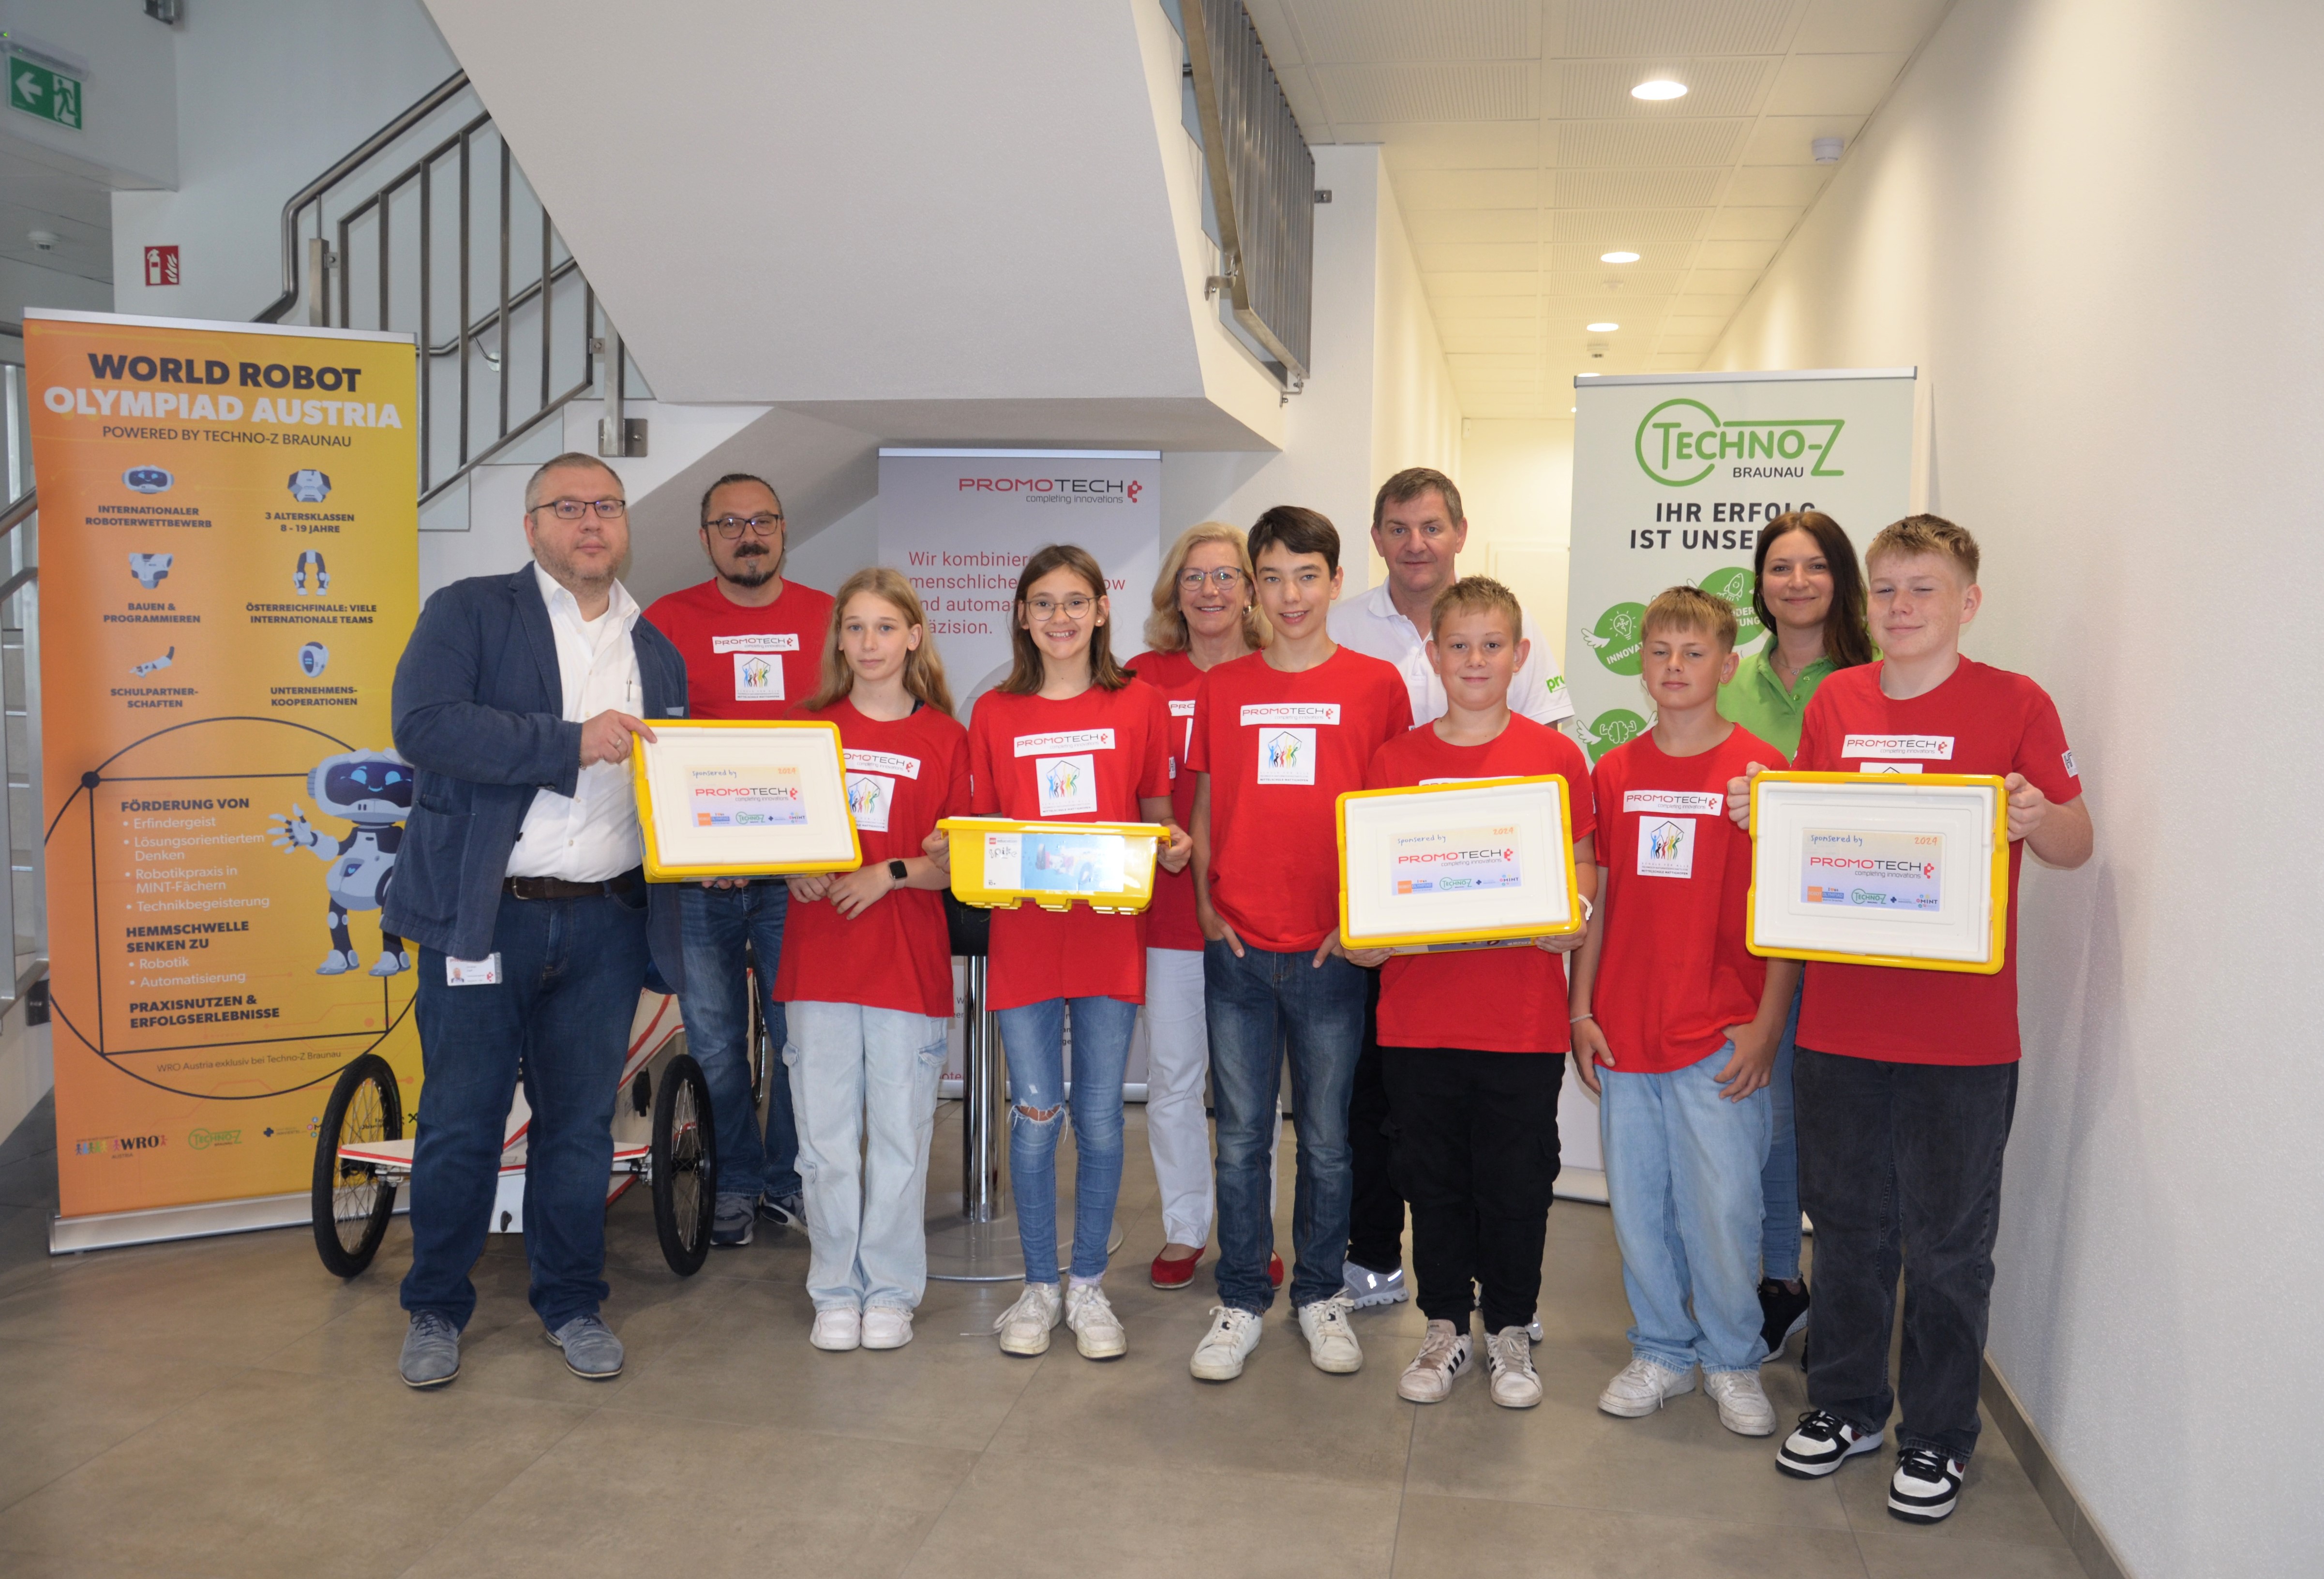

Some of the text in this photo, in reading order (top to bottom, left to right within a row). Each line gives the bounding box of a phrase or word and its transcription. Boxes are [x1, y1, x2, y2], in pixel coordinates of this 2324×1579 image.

[87, 353, 361, 391] WORLD ROBOT
[44, 387, 402, 428] OLYMPIAD AUSTRIA
[103, 427, 351, 447] POWERED BY TECHNO-Z BRAUNAU
[1733, 467, 1803, 478] BRAUNAU
[959, 478, 1123, 492] PROMOTECH
[1026, 494, 1123, 504] completing innovations
[98, 505, 199, 515] INTERNATIONALER
[274, 513, 354, 521] ALTERSKLASSEN
[1656, 503, 1702, 522] IHR
[86, 517, 212, 528] ROBOTERWETTBEWERB
[309, 525, 340, 534] JAHRE
[1631, 530, 1672, 549] IST
[909, 551, 1030, 566] Wir kombinier
[909, 575, 1017, 589] menschliche
[128, 603, 176, 611] BAUEN &
[246, 602, 348, 612] ÖSTERREICHFINALE:
[921, 597, 1014, 611] nd automa
[104, 615, 200, 623] PROGRAMMIEREN
[251, 615, 338, 624] INTERNATIONALE
[929, 621, 992, 634] äzision.
[1606, 641, 1643, 664] INNOVA
[111, 688, 198, 697] SCHULPARTNER-
[271, 698, 358, 706] KOOPERATIONEN
[1017, 734, 1098, 747] PROMOTECH
[1847, 739, 1936, 749] PROMOTECH
[843, 754, 905, 766] OMOTECH
[729, 770, 736, 778] by
[121, 798, 249, 812] FÖRDERUNG VON
[1627, 794, 1707, 804] PROMOTECH
[134, 817, 216, 830] Erfindergeist
[135, 834, 264, 849] Lösungsorientiertem
[1854, 835, 1862, 846] by
[135, 850, 184, 862] Denken
[1399, 849, 1501, 864] PROMOTECH
[1811, 857, 1920, 871] PROMOTECH
[136, 866, 238, 882] Robotikpraxis in
[136, 880, 226, 894] MINT-Fächern
[137, 895, 270, 912] Technikbegeisterung
[126, 921, 249, 938] HEMMSCHWELLE
[127, 938, 209, 953] SENKEN ZU
[140, 957, 189, 969] Robotik
[140, 972, 246, 988] Automatisierung
[130, 995, 256, 1013] PRAXISNUTZEN &
[130, 1008, 279, 1028] ERFOLGSERLEBNISSE
[157, 1050, 341, 1072] WRO Austria exklusiv bei Techno-Z Braunau
[121, 1135, 159, 1150] WRO
